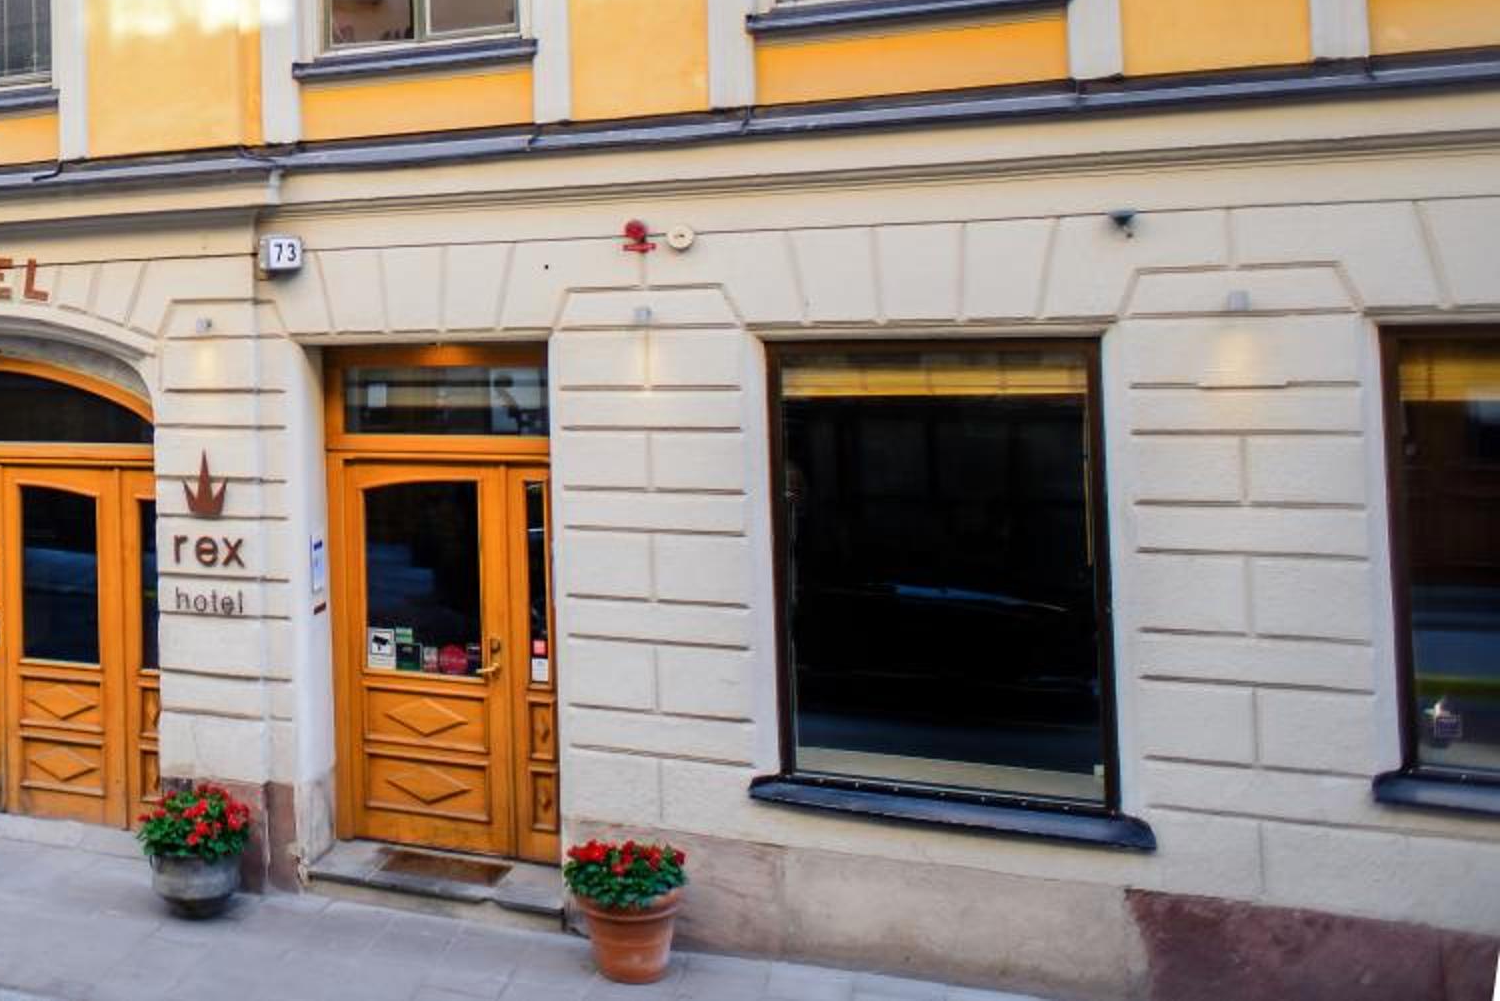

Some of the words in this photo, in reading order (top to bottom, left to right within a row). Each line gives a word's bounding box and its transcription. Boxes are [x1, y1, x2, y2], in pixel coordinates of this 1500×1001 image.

[273, 242, 297, 263] 73
[173, 534, 245, 568] rex
[175, 586, 244, 615] hotel
